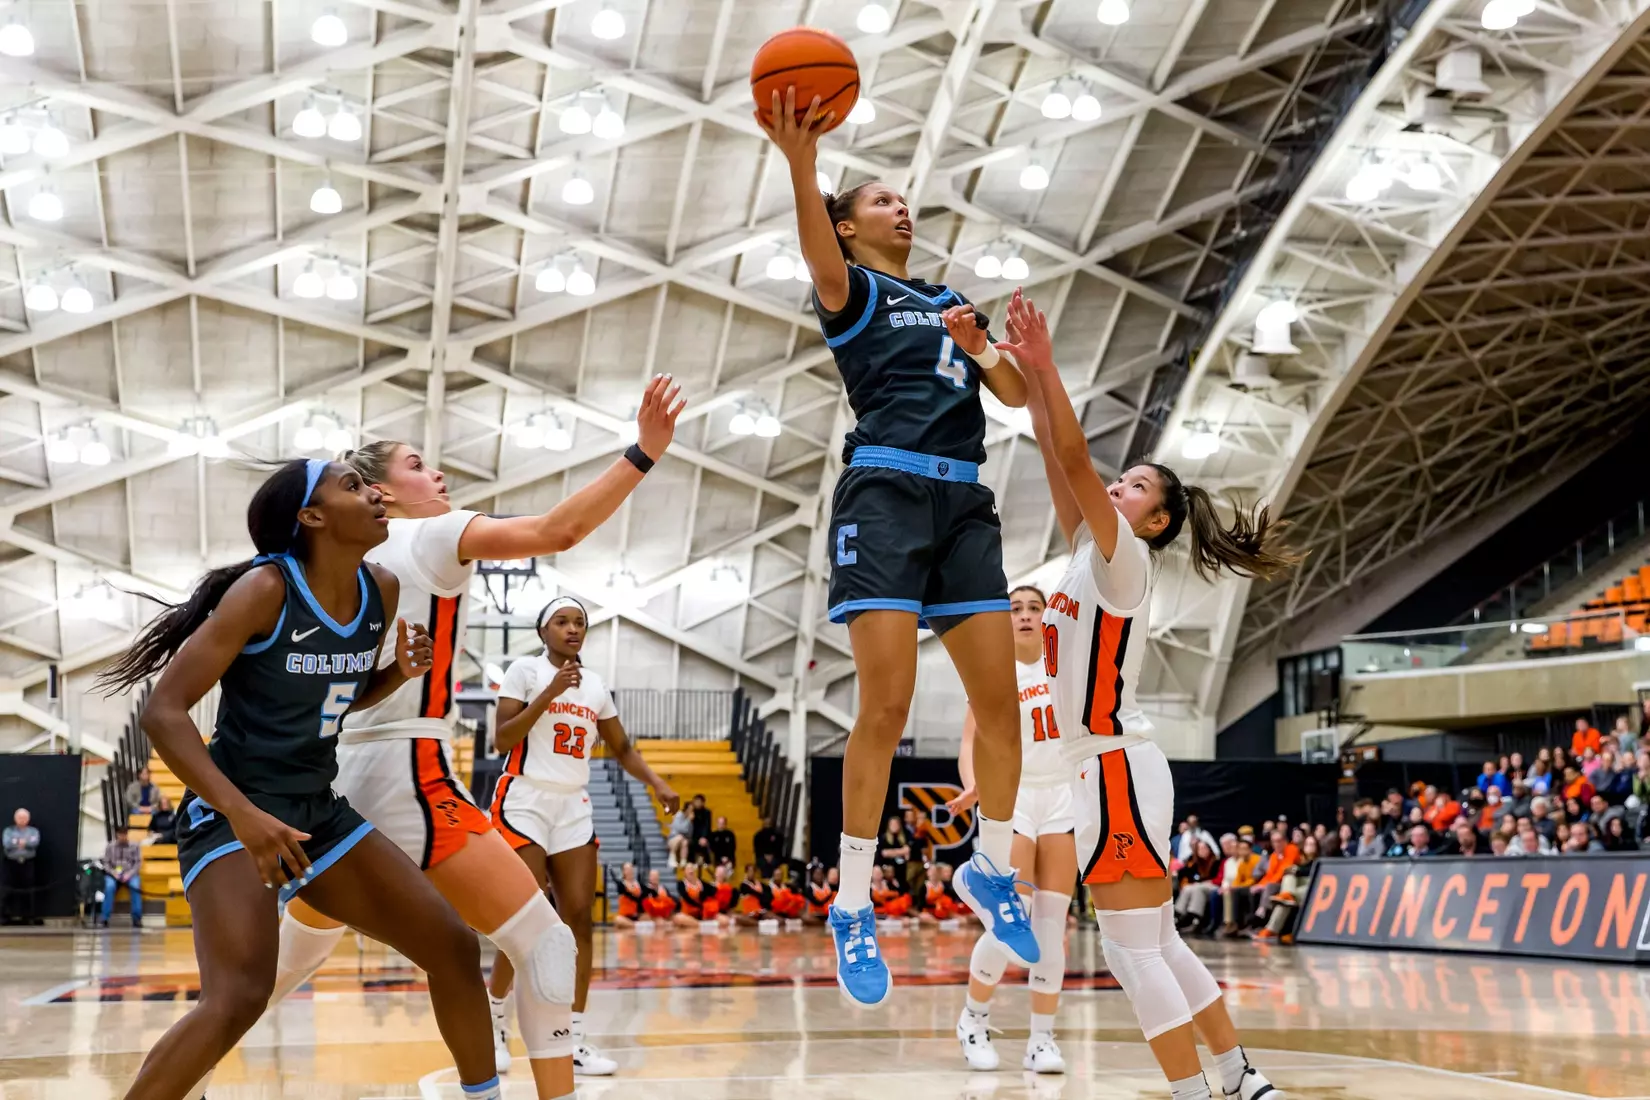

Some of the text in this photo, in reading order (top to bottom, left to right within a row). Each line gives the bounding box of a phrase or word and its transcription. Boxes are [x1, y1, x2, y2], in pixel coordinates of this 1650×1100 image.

[889, 311, 948, 328] COLU
[935, 335, 967, 389] 4
[836, 523, 858, 566] C
[1047, 591, 1080, 620] TON
[369, 622, 382, 632] Ivy
[1041, 622, 1058, 678] 0
[319, 682, 358, 739] 5
[547, 702, 598, 722] RINCETO
[553, 722, 587, 759] 23
[1112, 832, 1135, 860] P
[1304, 873, 1648, 948] PRINCETON
